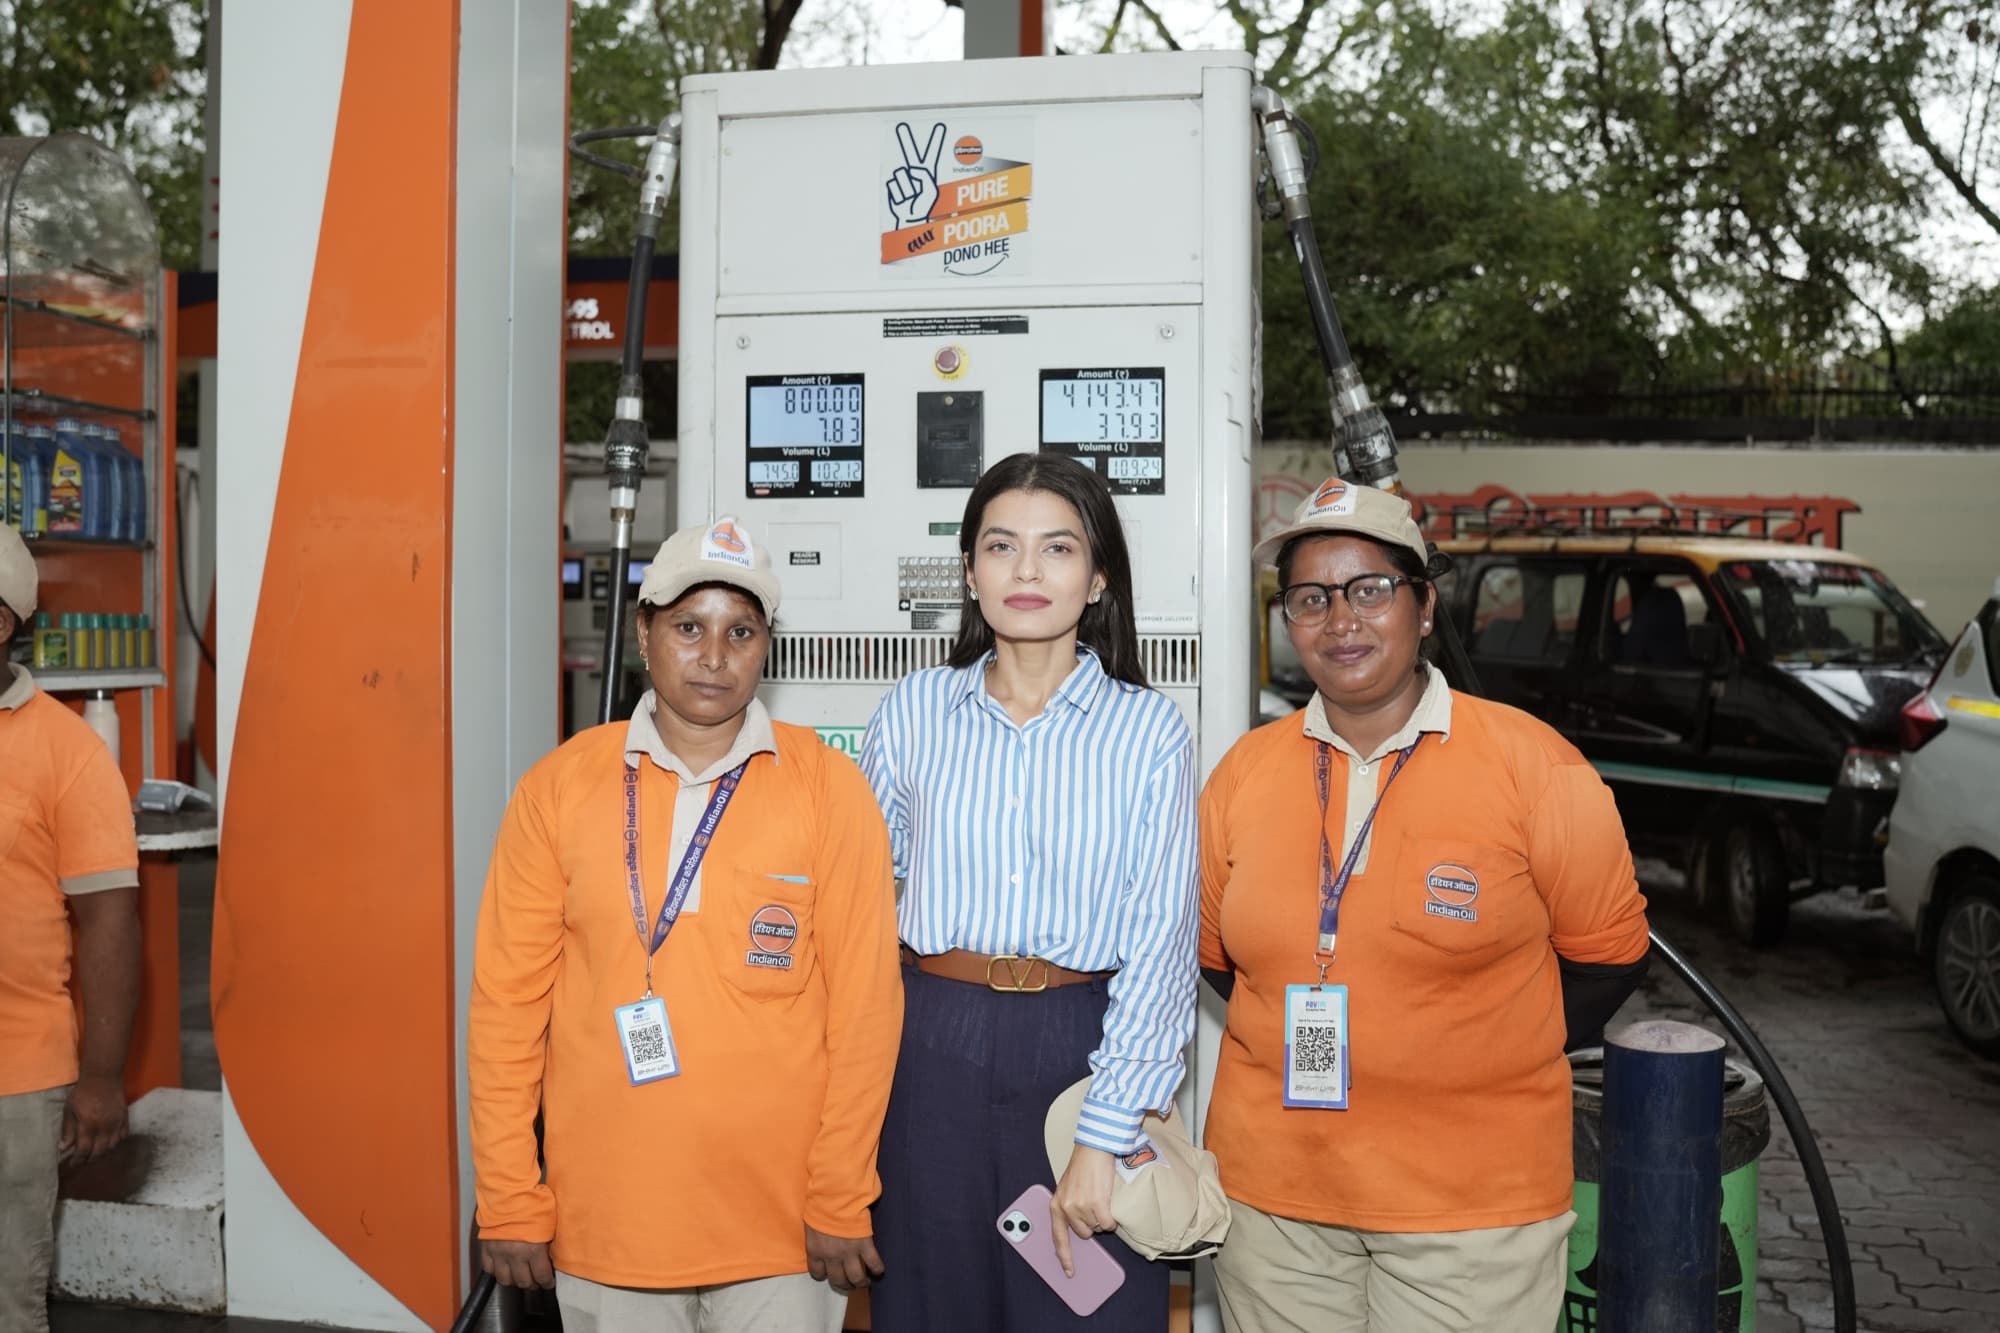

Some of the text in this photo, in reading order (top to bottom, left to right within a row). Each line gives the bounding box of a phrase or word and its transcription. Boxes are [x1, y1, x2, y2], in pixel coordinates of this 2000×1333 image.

[957, 176, 1009, 206] PURE
[943, 211, 1010, 245] POORA
[943, 238, 1010, 265] DONO HEE
[782, 376, 816, 385] Amount
[1077, 370, 1113, 379] Amount
[785, 386, 860, 414] 800.00
[1063, 381, 1159, 408] 4143.47
[818, 417, 860, 443] 7.83
[1099, 412, 1159, 439] 37.93
[782, 447, 815, 456] Volume
[1077, 443, 1112, 452] Volume
[626, 784, 636, 828] IndianOil
[702, 790, 729, 834] IndianOil
